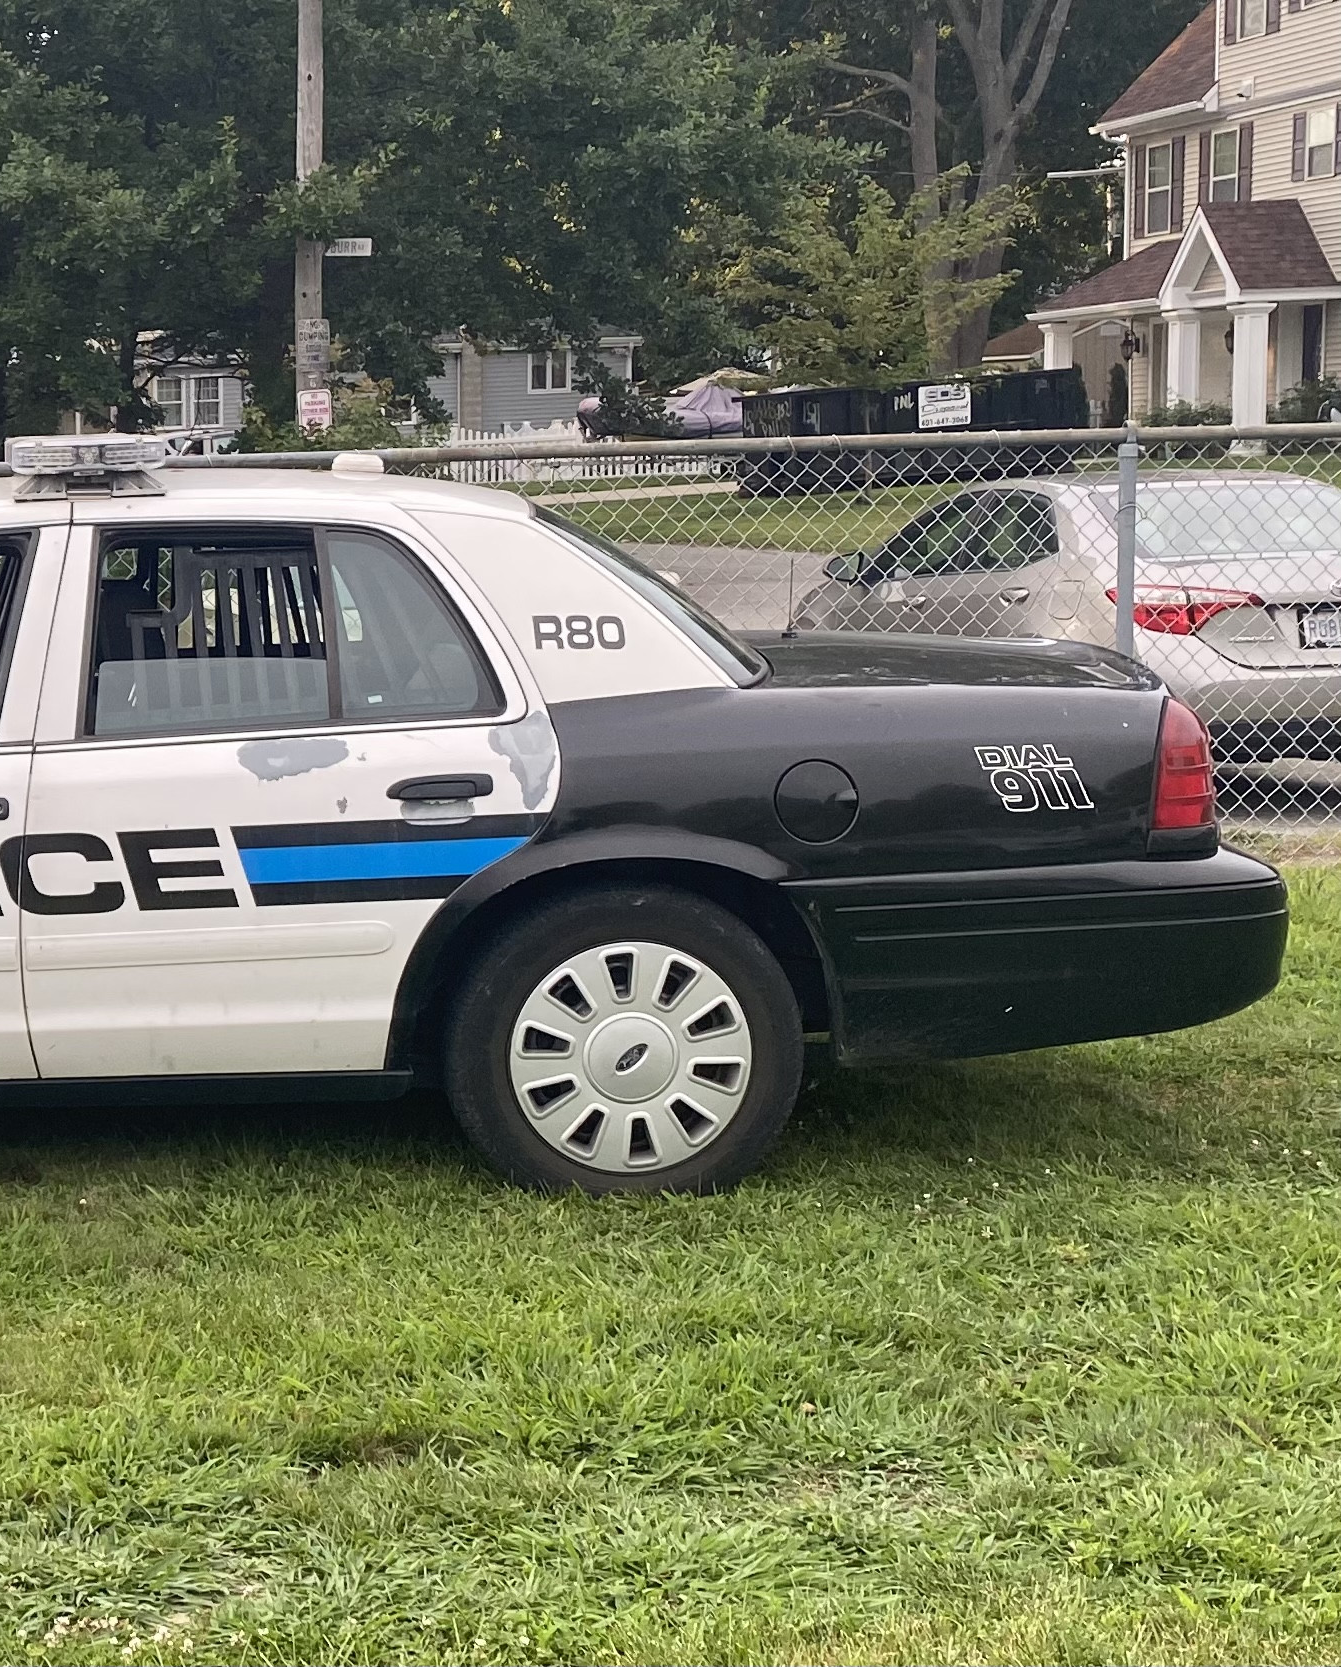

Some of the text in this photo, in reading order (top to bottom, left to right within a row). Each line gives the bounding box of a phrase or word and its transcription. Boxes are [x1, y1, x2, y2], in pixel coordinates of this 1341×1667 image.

[299, 331, 329, 342] DUMPING
[532, 615, 626, 649] R80
[974, 743, 1074, 770] DIAL
[990, 767, 1095, 813] 911
